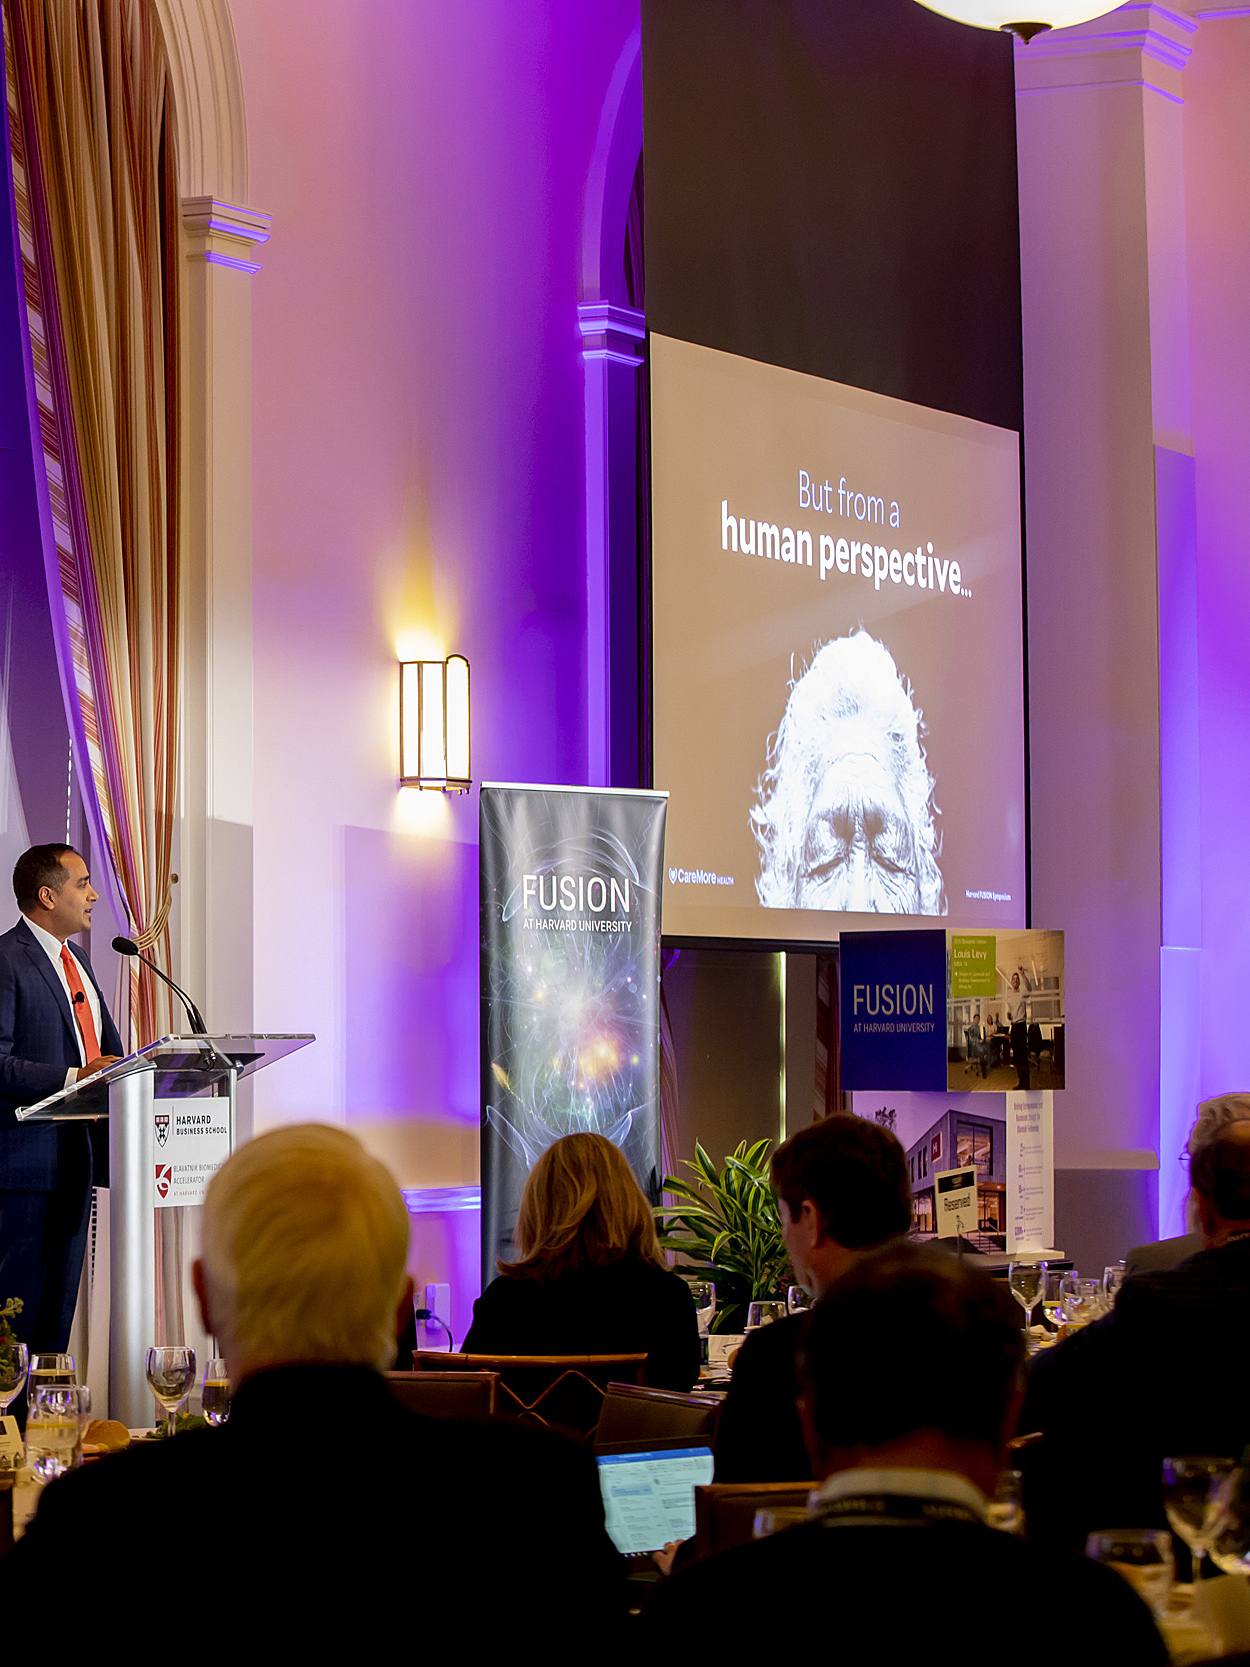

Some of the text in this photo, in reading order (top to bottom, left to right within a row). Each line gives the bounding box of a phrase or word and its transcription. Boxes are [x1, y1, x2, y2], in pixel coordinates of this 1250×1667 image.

[799, 470, 900, 528] But from a
[721, 500, 972, 598] human perspective...
[678, 868, 734, 886] CareMore HEALTH
[522, 874, 630, 913] FUSION
[523, 918, 632, 932] AT HARVARD UNIVERSITY
[954, 949, 987, 960] Louis Levy
[853, 984, 933, 1016] FUSION
[854, 1022, 934, 1033] AT HARVARD UNIVERSITY
[176, 1115, 211, 1125] HARVARD
[205, 1126, 228, 1134] SCHOOL
[174, 1164, 198, 1172] BLAVATNIK
[173, 1176, 204, 1184] ACCELERATOR
[943, 1193, 971, 1212] Reserved
